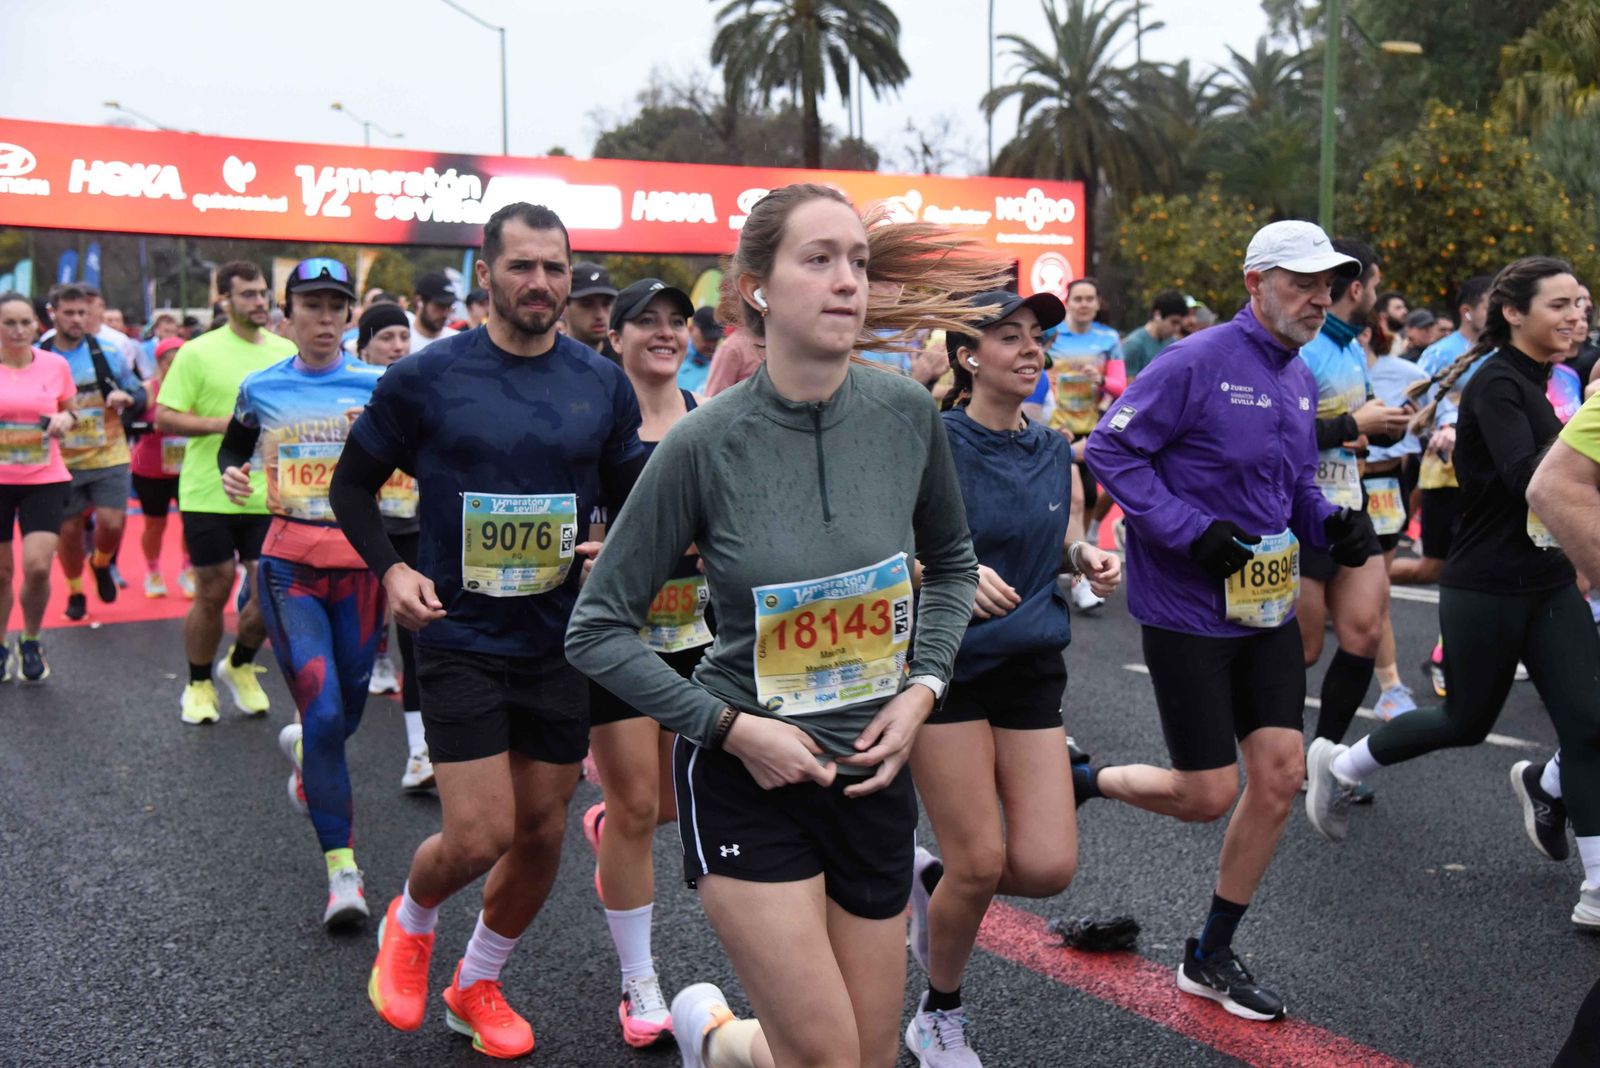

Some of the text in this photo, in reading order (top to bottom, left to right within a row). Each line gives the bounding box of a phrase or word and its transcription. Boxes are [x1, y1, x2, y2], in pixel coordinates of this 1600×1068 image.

[68, 158, 187, 200] HOKA
[630, 189, 718, 224] HOKA
[1230, 384, 1254, 393] ZURICH
[1230, 397, 1255, 406] SEVILLA
[481, 520, 552, 552] 9076
[771, 598, 892, 651] 18143
